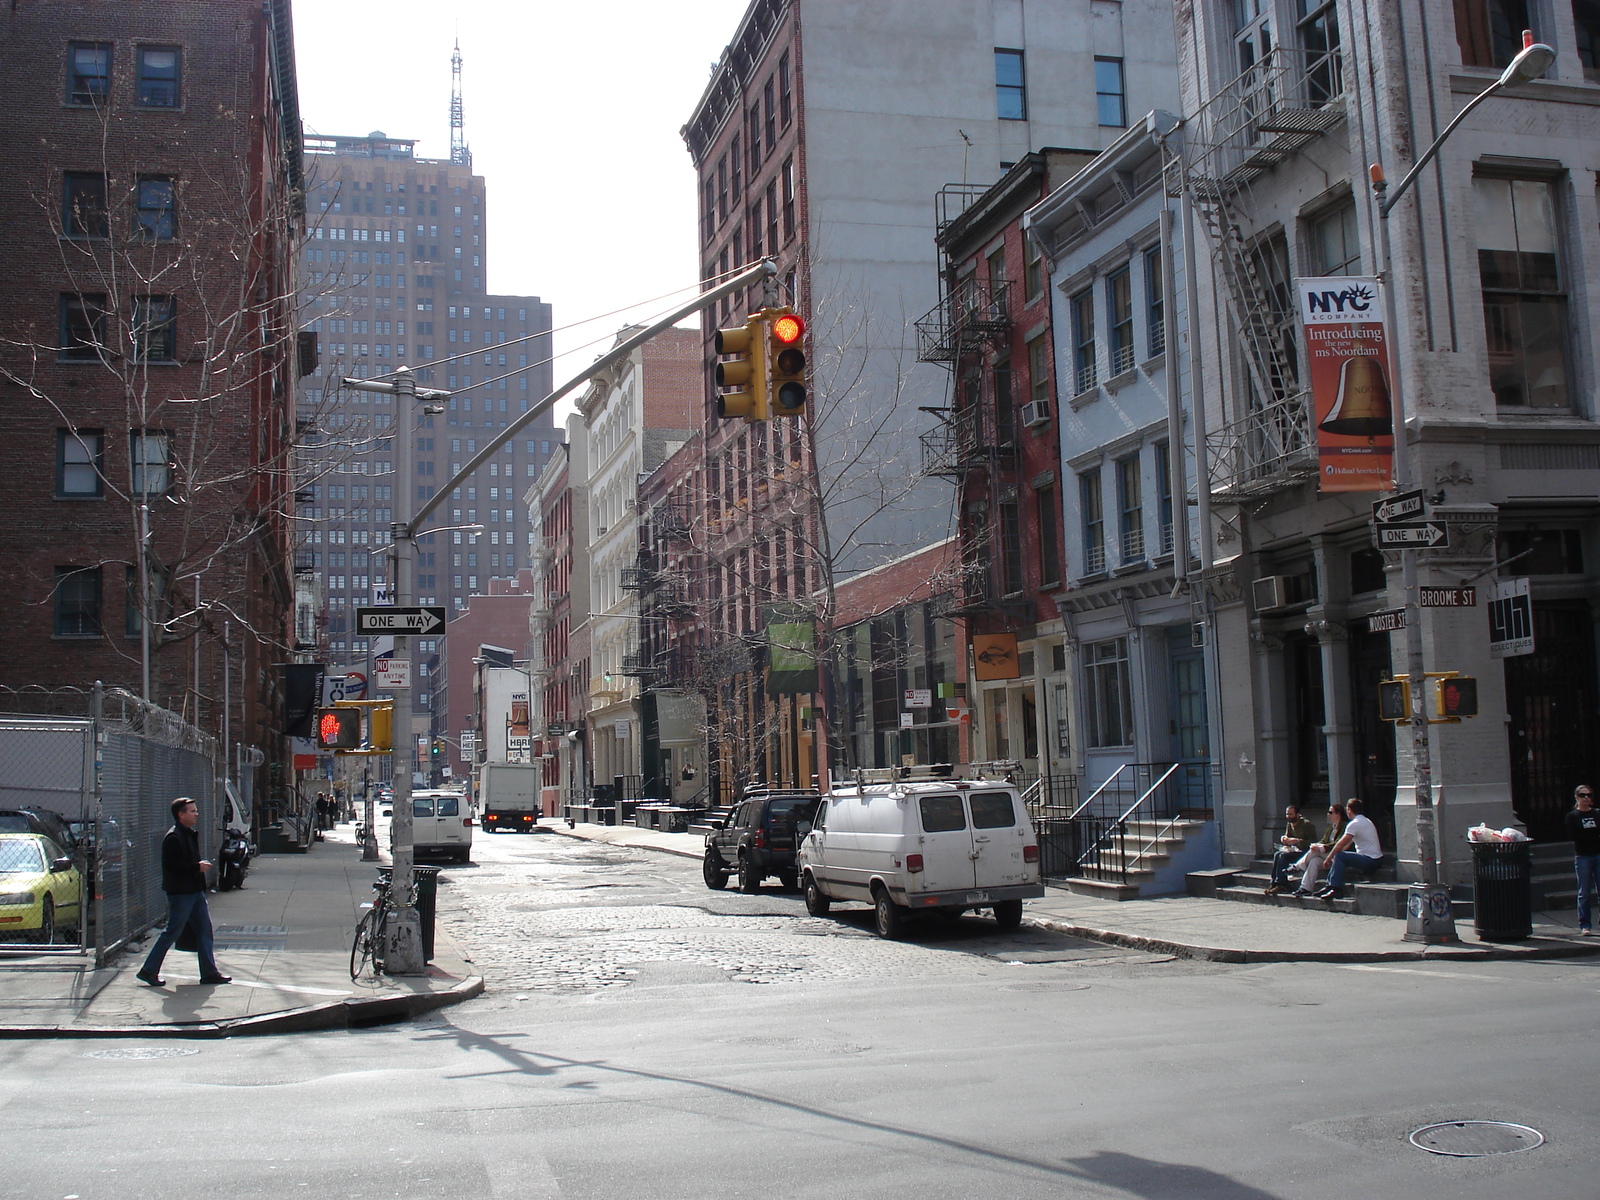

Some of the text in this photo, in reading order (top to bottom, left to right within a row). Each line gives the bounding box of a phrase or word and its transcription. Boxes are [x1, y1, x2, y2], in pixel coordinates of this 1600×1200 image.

[1308, 289, 1370, 313] NYC
[1308, 326, 1383, 342] Introducing
[1315, 345, 1379, 357] ms Noordam
[1380, 499, 1417, 518] ONE WAY
[1387, 529, 1436, 541] ONE WAY
[1421, 590, 1473, 606] BROOME ST
[370, 616, 432, 627] ONE WAY
[1368, 614, 1395, 632] WOOSTER
[377, 661, 388, 671] NO
